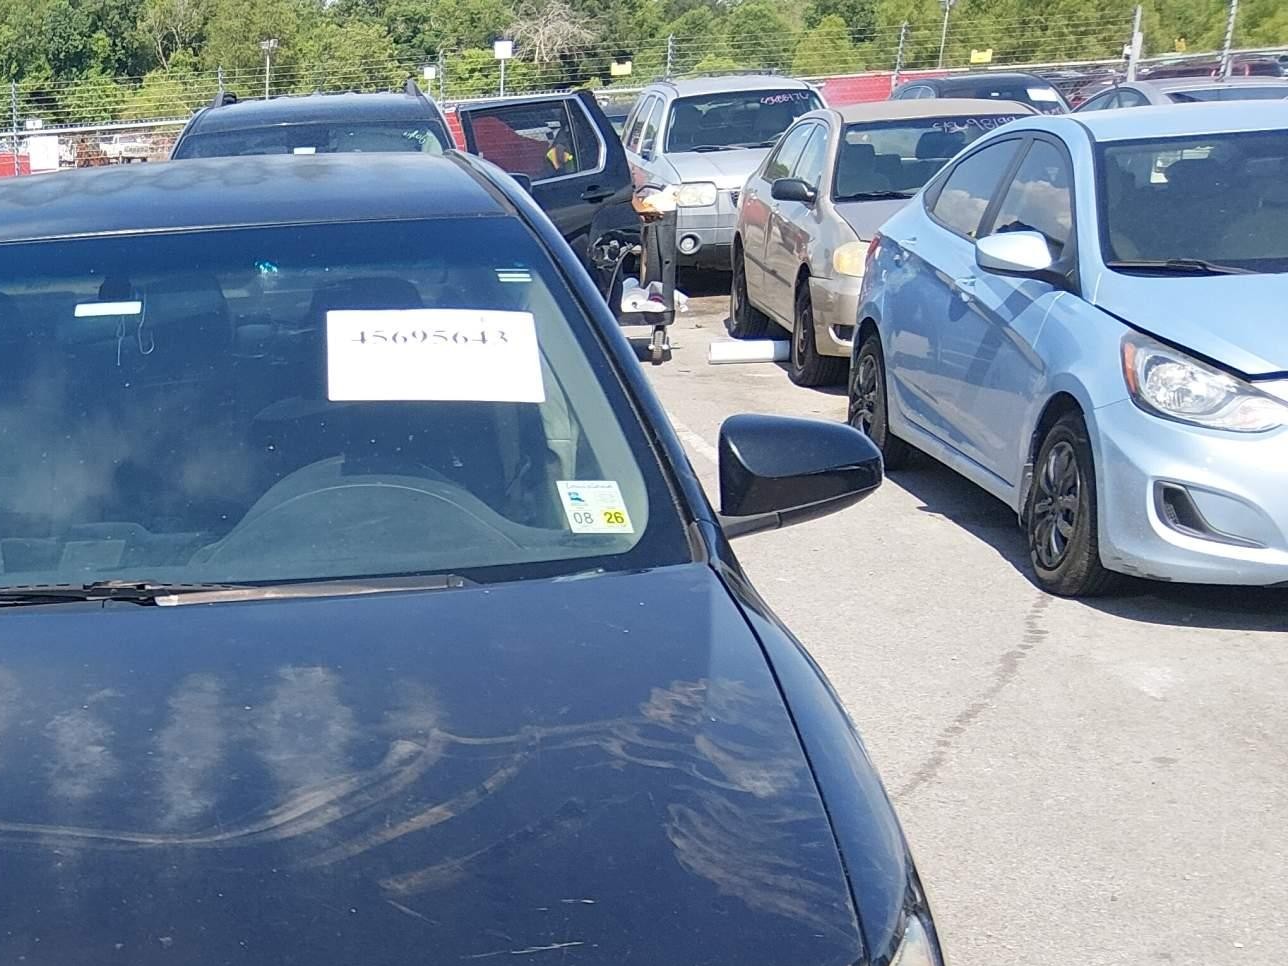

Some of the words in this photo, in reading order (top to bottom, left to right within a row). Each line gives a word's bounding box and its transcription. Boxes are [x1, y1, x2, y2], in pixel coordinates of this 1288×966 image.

[351, 330, 509, 344] 45695643
[573, 512, 594, 524] 08
[604, 511, 624, 524] 26
